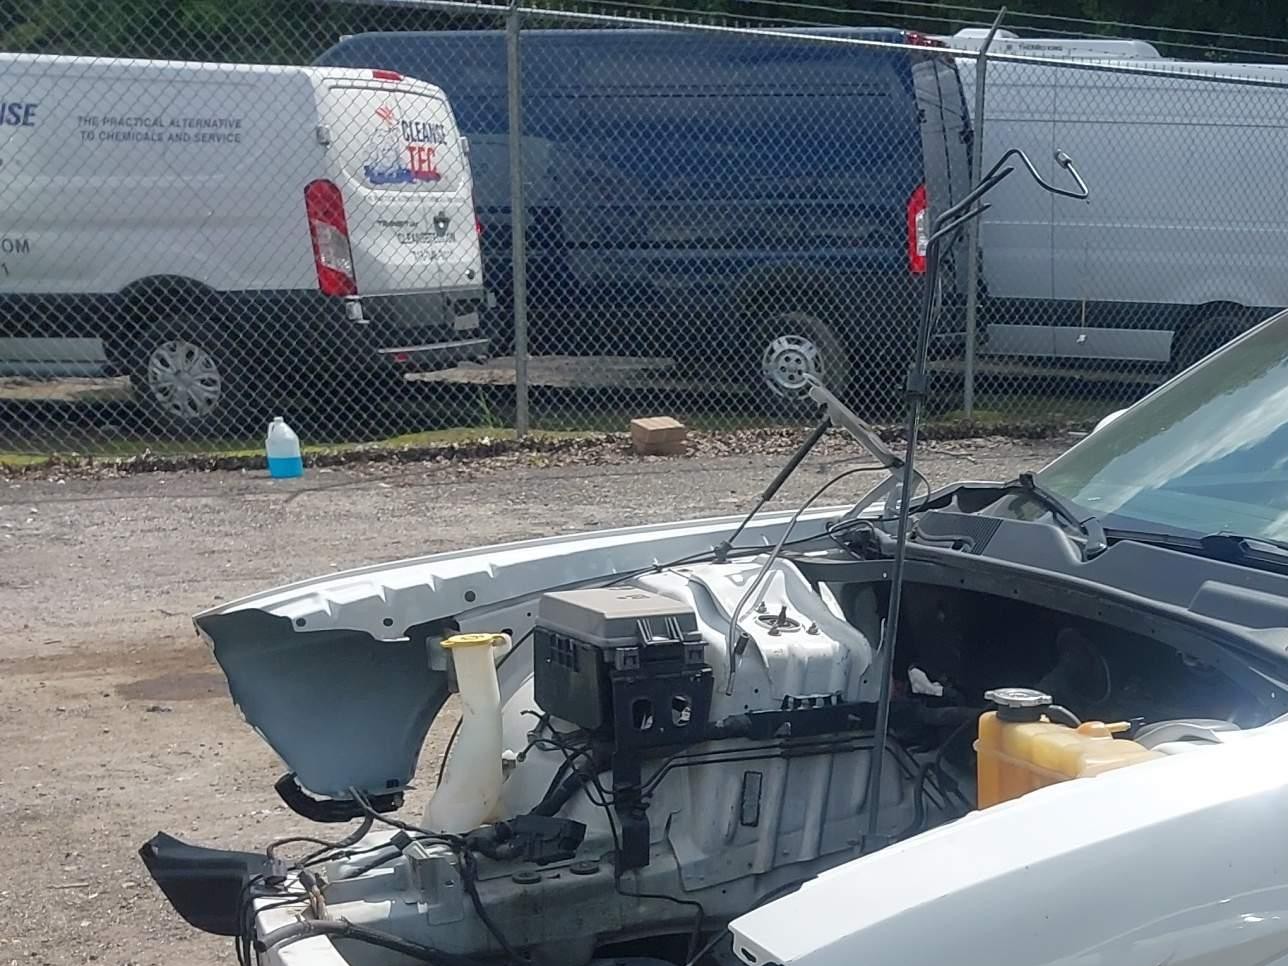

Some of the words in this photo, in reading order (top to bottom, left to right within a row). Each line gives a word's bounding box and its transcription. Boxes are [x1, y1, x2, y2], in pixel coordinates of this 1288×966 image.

[78, 115, 98, 127] THE
[102, 116, 165, 128] PRACTICAL
[169, 118, 242, 129] ALTERNATIVE
[401, 119, 447, 145] CLEANSE
[80, 130, 95, 142] TO
[99, 131, 164, 143] CHEMICALS
[168, 132, 191, 143] AND
[194, 132, 242, 144] SERVICE
[406, 145, 437, 173] TEC
